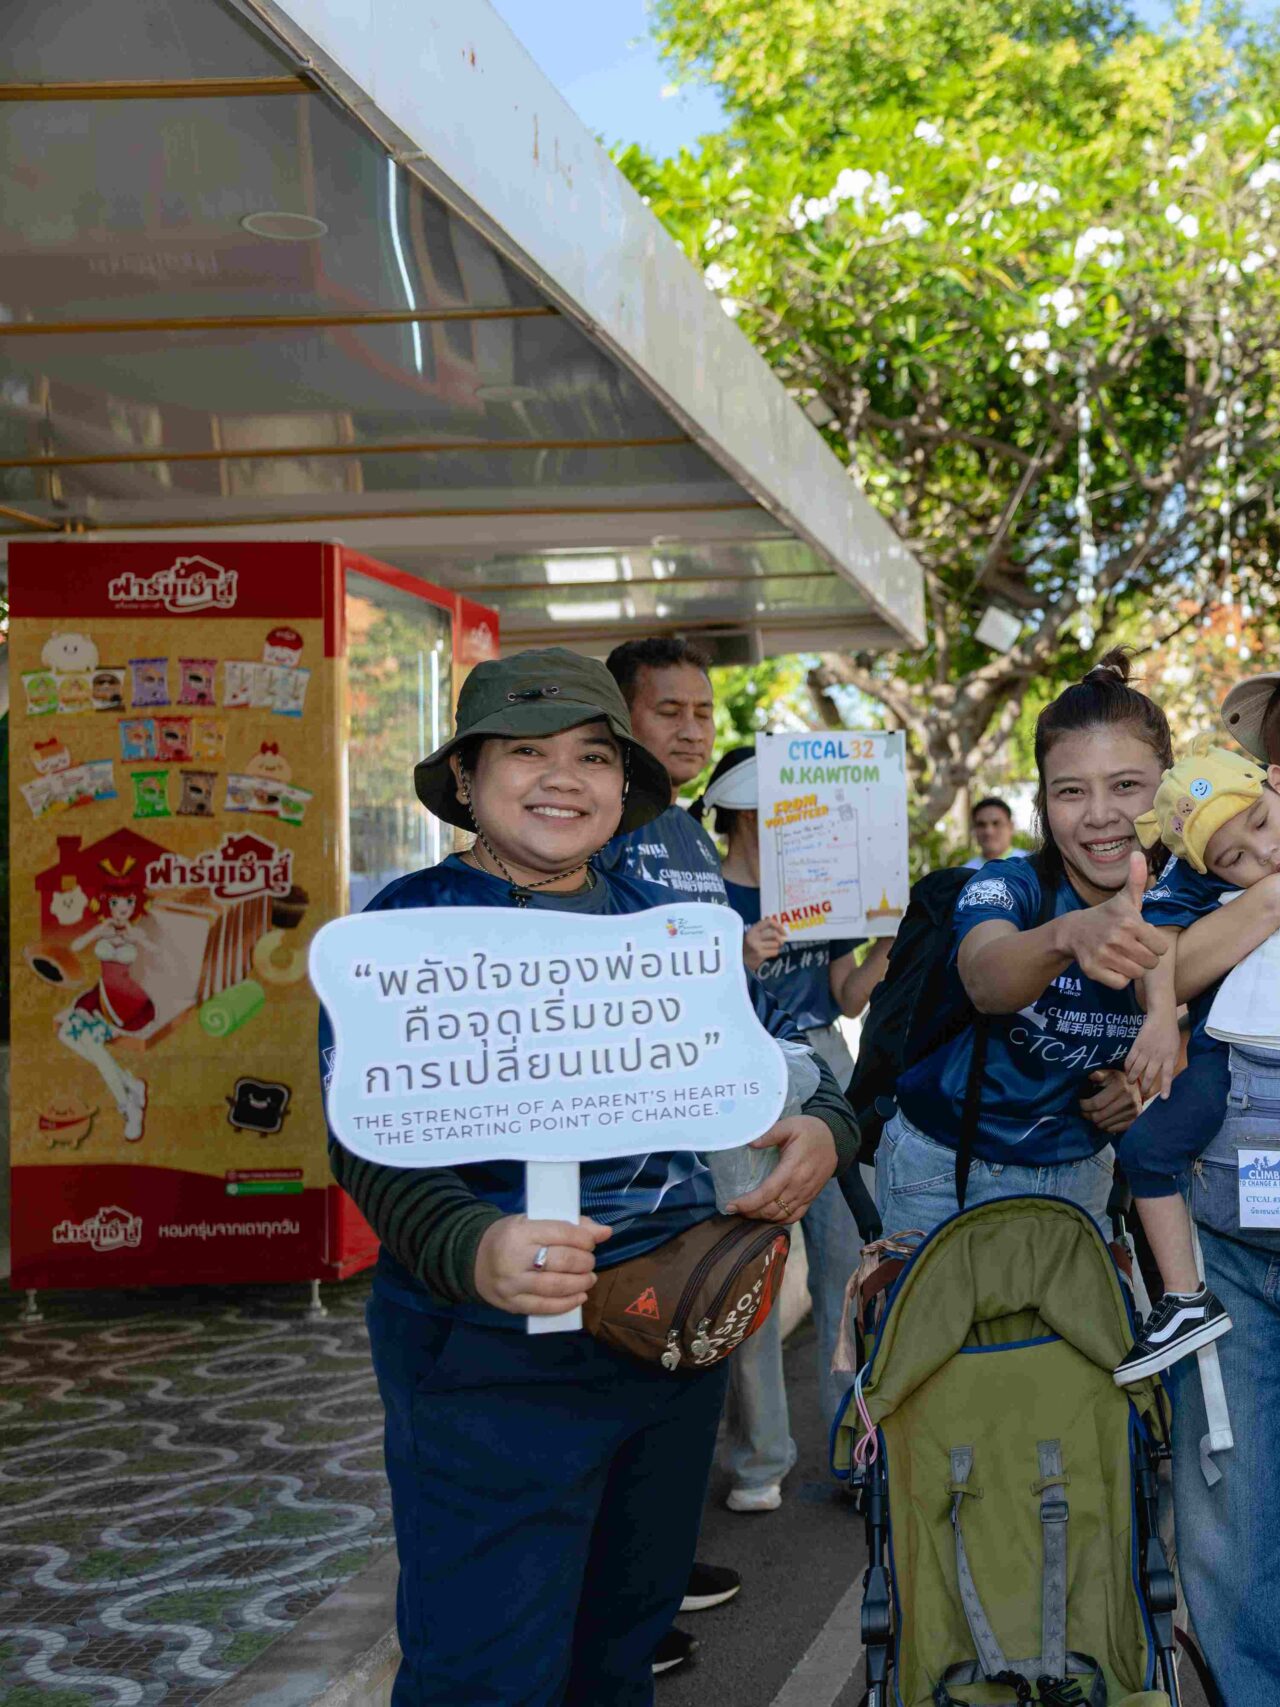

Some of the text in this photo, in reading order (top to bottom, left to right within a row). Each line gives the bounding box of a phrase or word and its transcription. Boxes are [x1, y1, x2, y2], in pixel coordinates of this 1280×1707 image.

[779, 765, 880, 785] N.KAWTOM
[354, 936, 722, 997] “พลังใจของพ่อแม่
[405, 988, 681, 1048] คือจุดเริ่มของ
[1048, 1007, 1087, 1023] CLIMB
[1089, 1013, 1104, 1023] TO
[366, 1031, 721, 1093] การเปลี่ยนแปลง”
[1010, 1027, 1102, 1069] CTCAL
[353, 1114, 393, 1130] THE
[401, 1104, 509, 1126] STRENGTH
[517, 1100, 545, 1115] OF
[551, 1099, 564, 1112] A
[674, 1083, 737, 1101] HEART
[743, 1082, 760, 1095] IS
[374, 1103, 719, 1146] THE STARTING POINT OF CHANGE.
[1248, 1170, 1280, 1180] CLIMB
